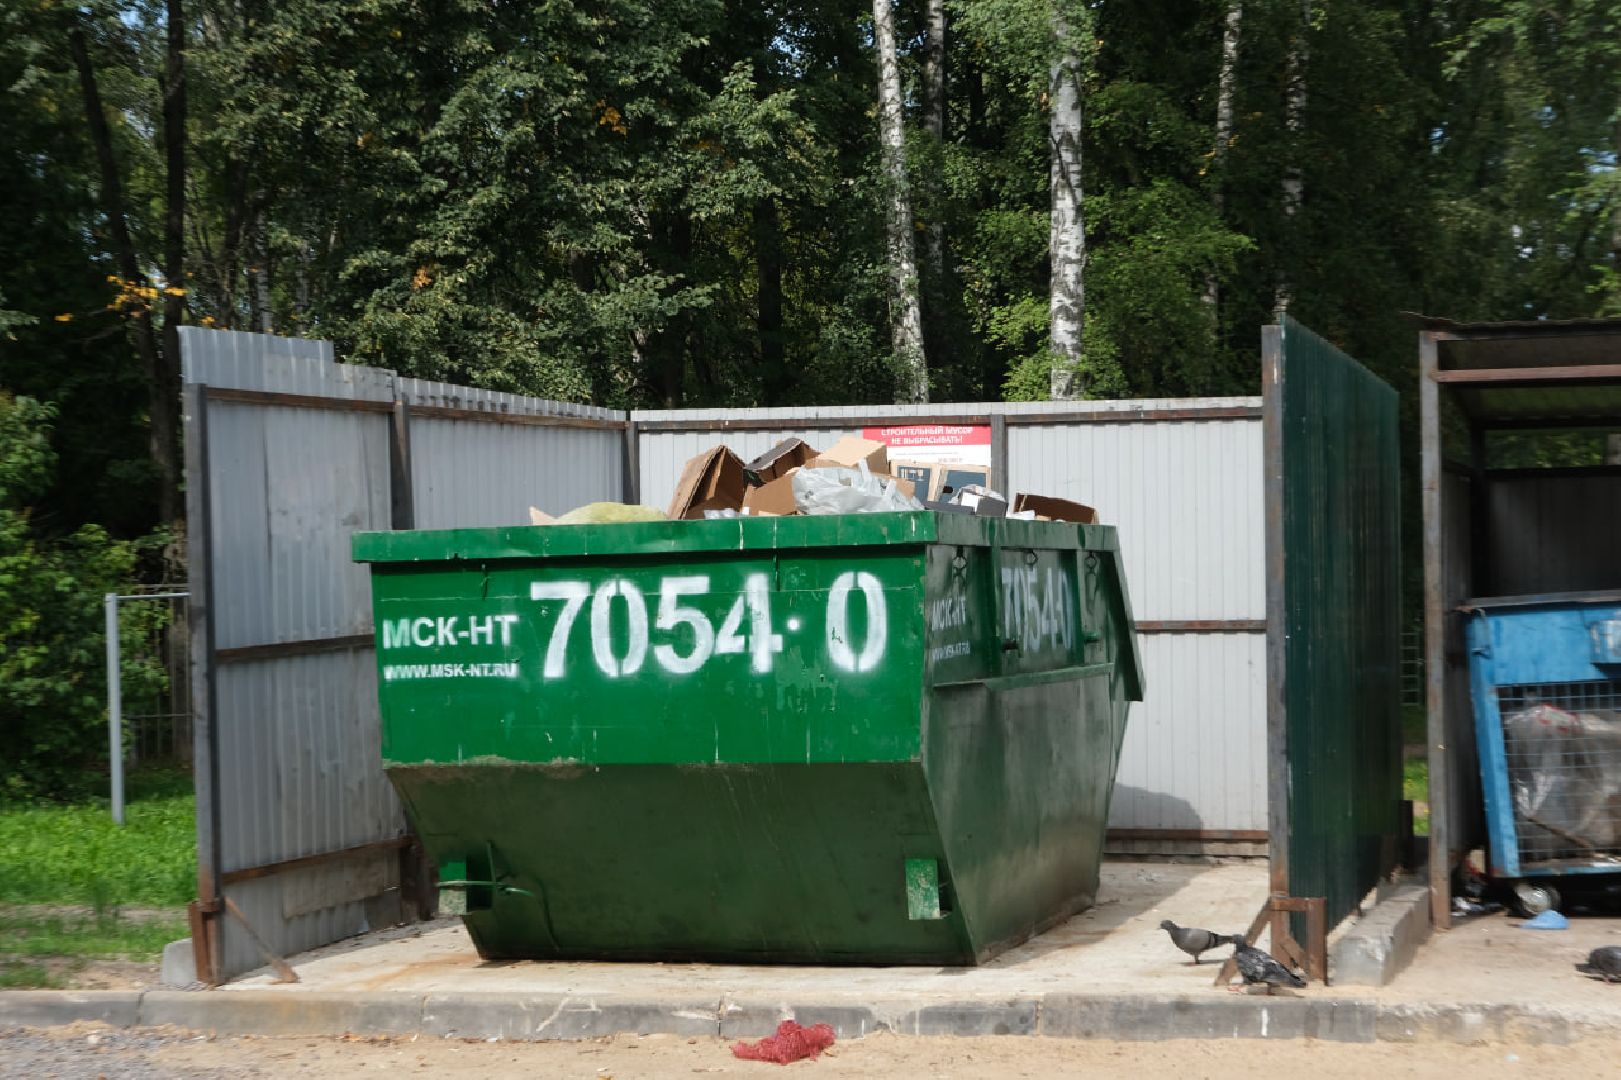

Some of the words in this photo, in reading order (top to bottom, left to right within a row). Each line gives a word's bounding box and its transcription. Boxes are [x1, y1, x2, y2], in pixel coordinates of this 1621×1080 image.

[881, 426, 944, 436] СТРОИТЕЛЬНЫЙ
[946, 426, 973, 435] МУСОР
[891, 437, 901, 445] НЕ
[903, 436, 963, 445] ВЫБРАСЫВАТЬ!
[382, 614, 520, 649] МСК-НТ
[383, 662, 519, 680] WWW.MSK-NT.RU
